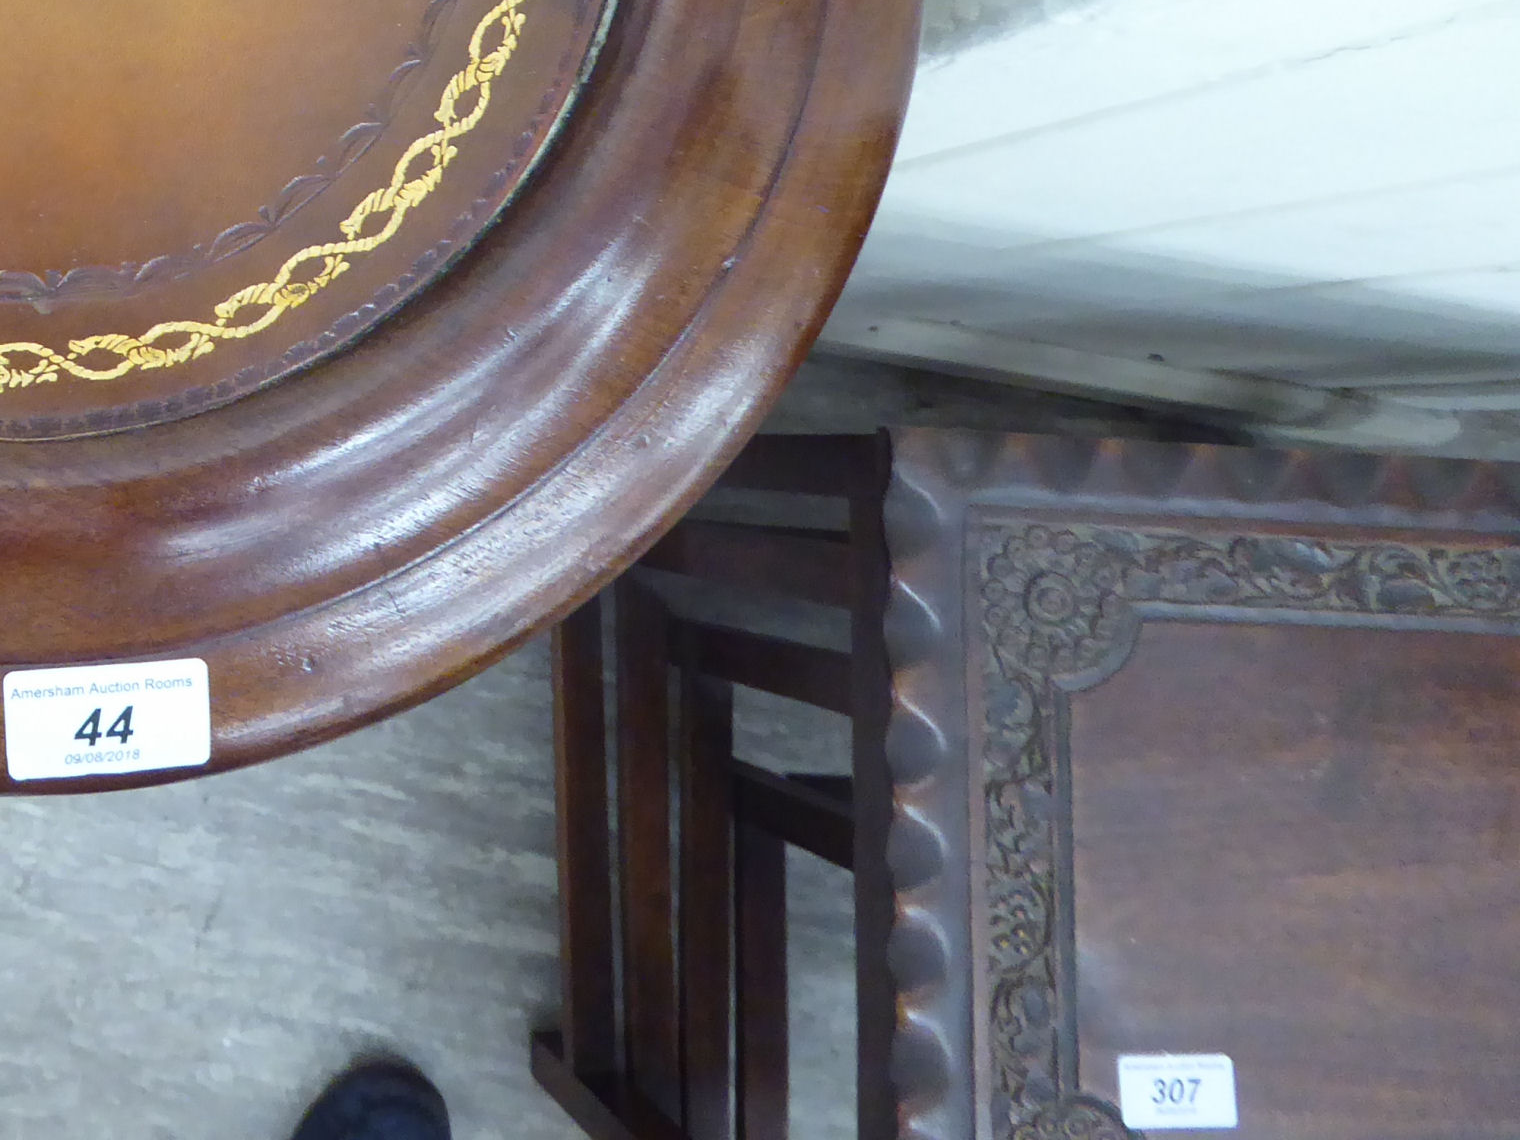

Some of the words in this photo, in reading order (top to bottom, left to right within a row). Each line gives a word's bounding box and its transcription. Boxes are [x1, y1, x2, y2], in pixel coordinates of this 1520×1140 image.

[10, 686, 85, 700] Amersham
[88, 680, 140, 694] Auction
[144, 676, 193, 690] Rooms
[74, 706, 134, 746] 44
[1151, 1078, 1202, 1105] 307
